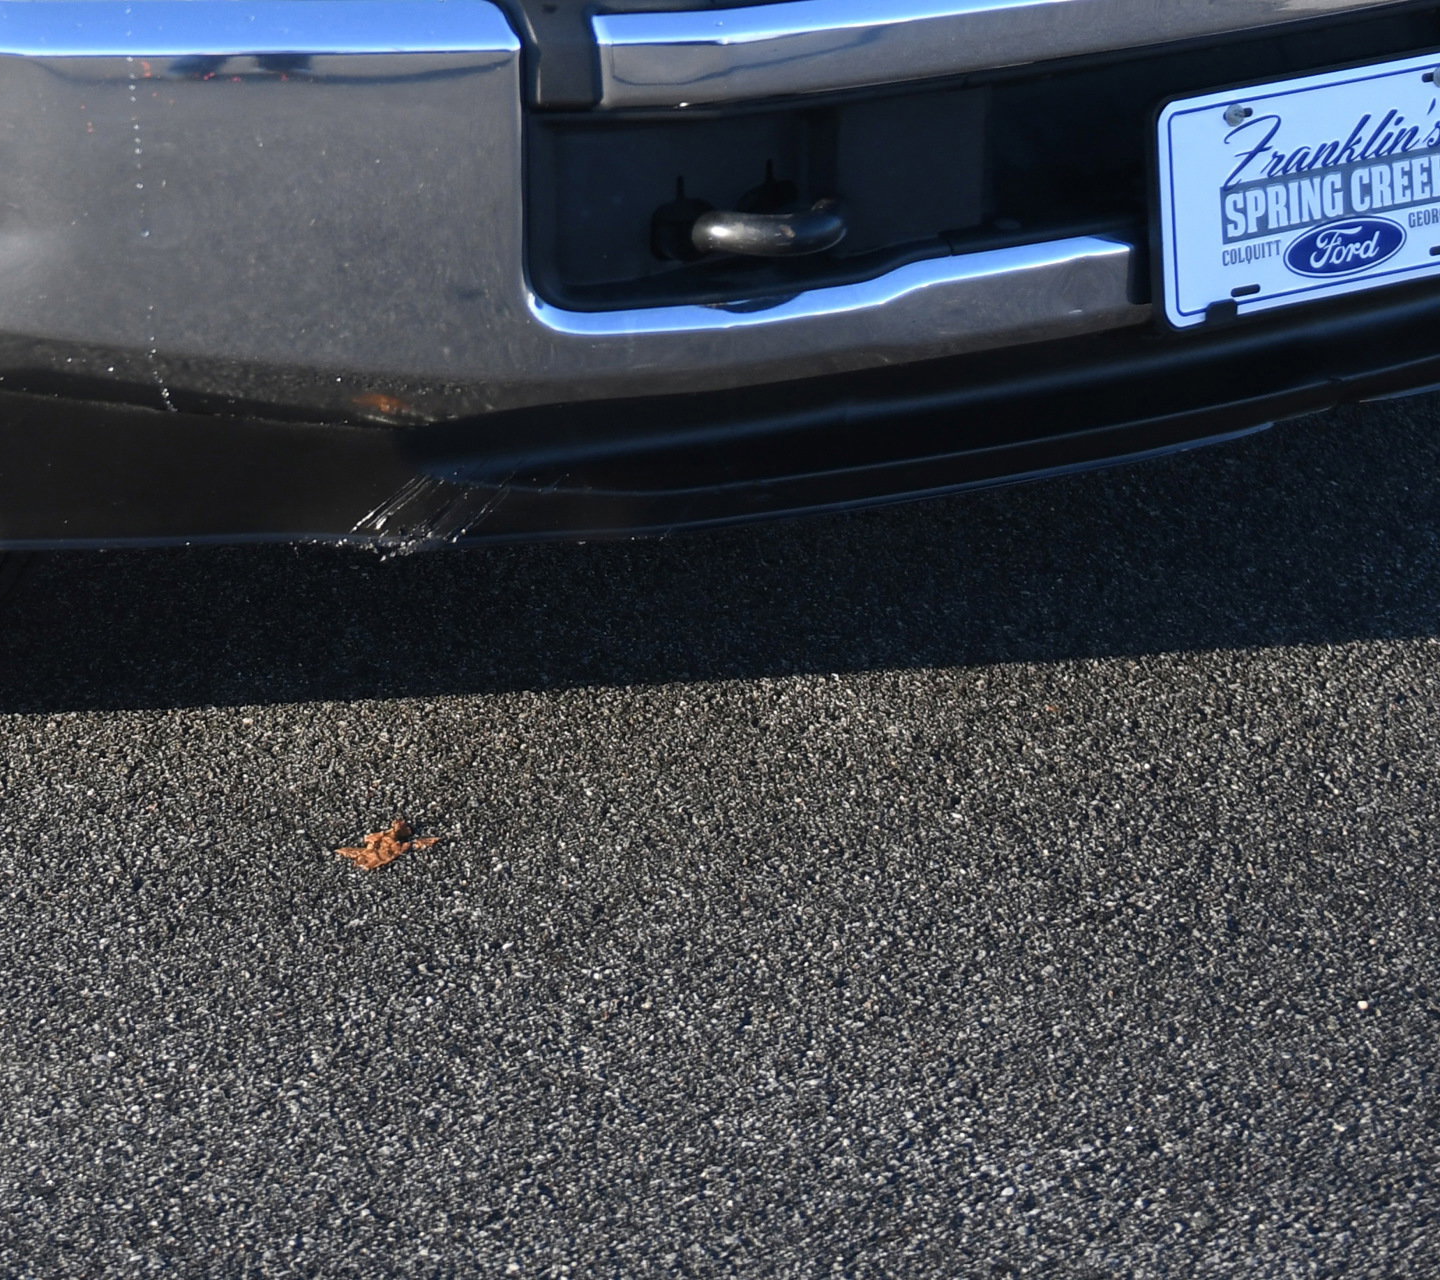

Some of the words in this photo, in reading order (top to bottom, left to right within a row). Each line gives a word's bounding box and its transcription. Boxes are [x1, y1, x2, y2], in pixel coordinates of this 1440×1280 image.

[1225, 173, 1344, 238] SPRING
[1221, 239, 1282, 267] COLQUITT
[1309, 224, 1381, 269] Ford
